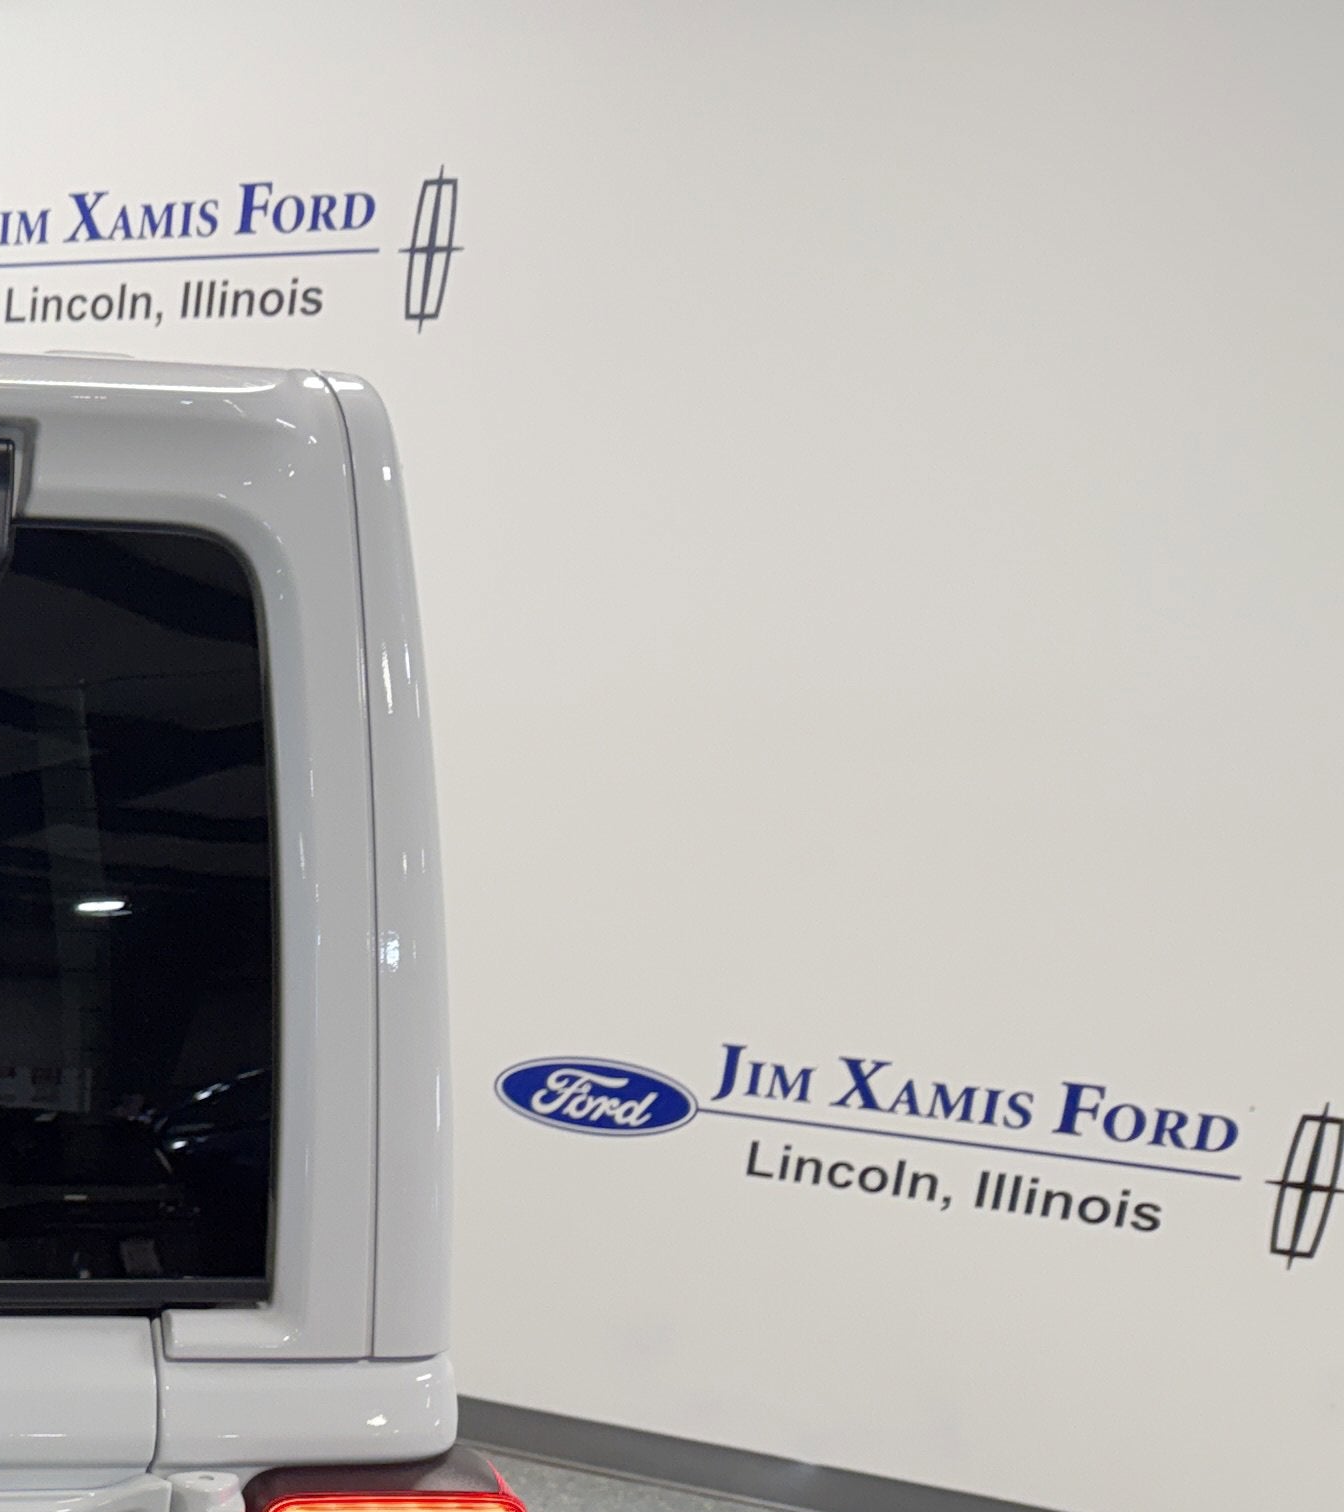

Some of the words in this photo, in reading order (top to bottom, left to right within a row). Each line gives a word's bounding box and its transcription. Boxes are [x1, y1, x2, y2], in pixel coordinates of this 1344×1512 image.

[63, 190, 219, 243] XAMIS
[234, 181, 376, 235] FORD
[3, 283, 164, 327] Lincoln,
[179, 277, 324, 319] Illinois
[530, 1067, 653, 1132] Ford
[710, 1043, 818, 1106] JIM
[829, 1056, 1037, 1132] XAMIS
[1052, 1080, 1241, 1155] FORD
[745, 1140, 954, 1212] Lincoln,
[973, 1170, 1164, 1234] Illinois
